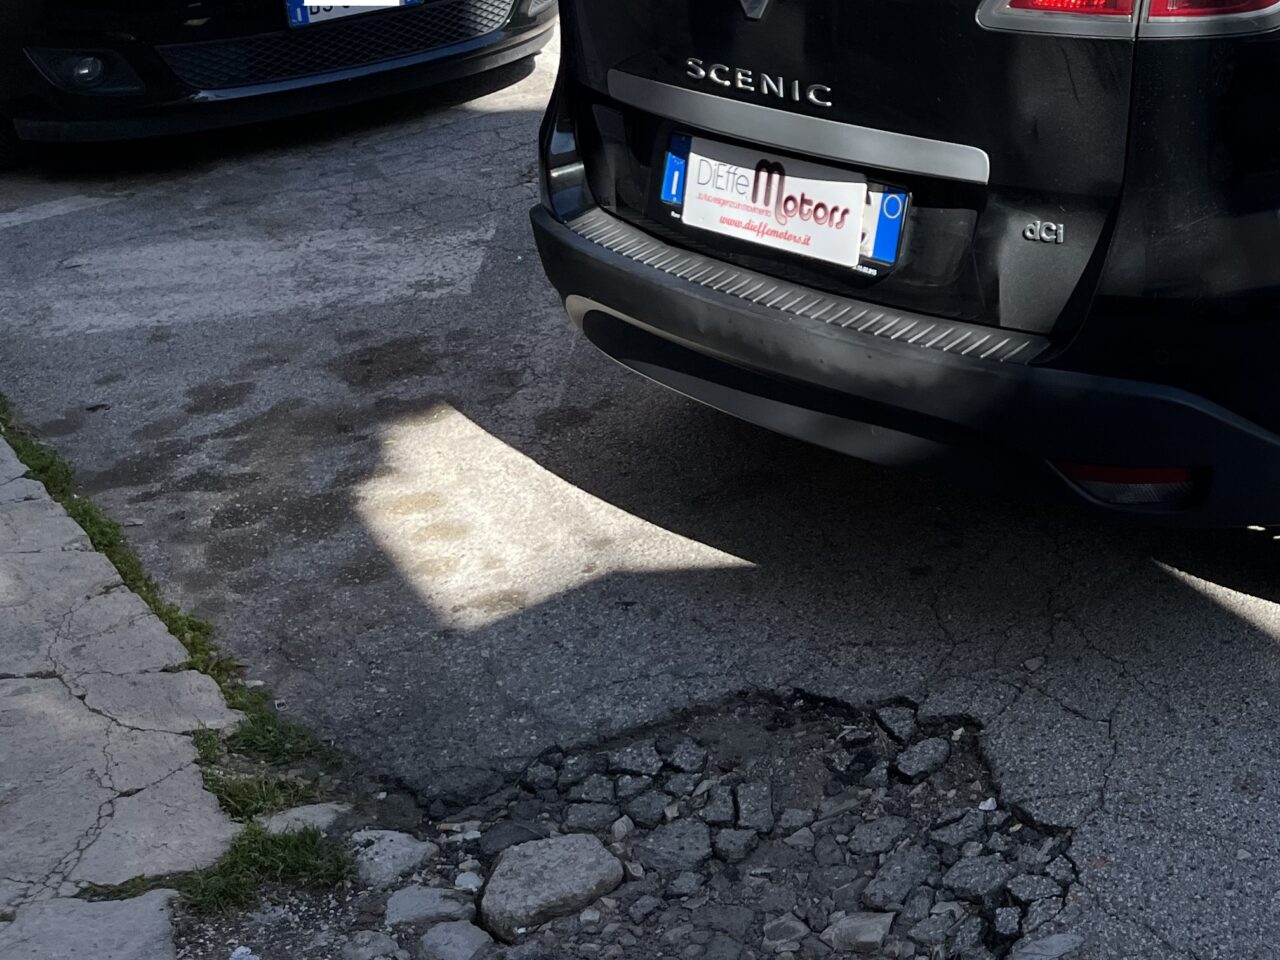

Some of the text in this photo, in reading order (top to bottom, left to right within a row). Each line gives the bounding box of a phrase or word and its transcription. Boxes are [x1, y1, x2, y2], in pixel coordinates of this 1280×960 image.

[686, 57, 833, 107] SCENIC
[697, 158, 749, 196] DiEffe
[753, 158, 851, 230] Motors
[719, 212, 811, 247] www.dieffemotors.it
